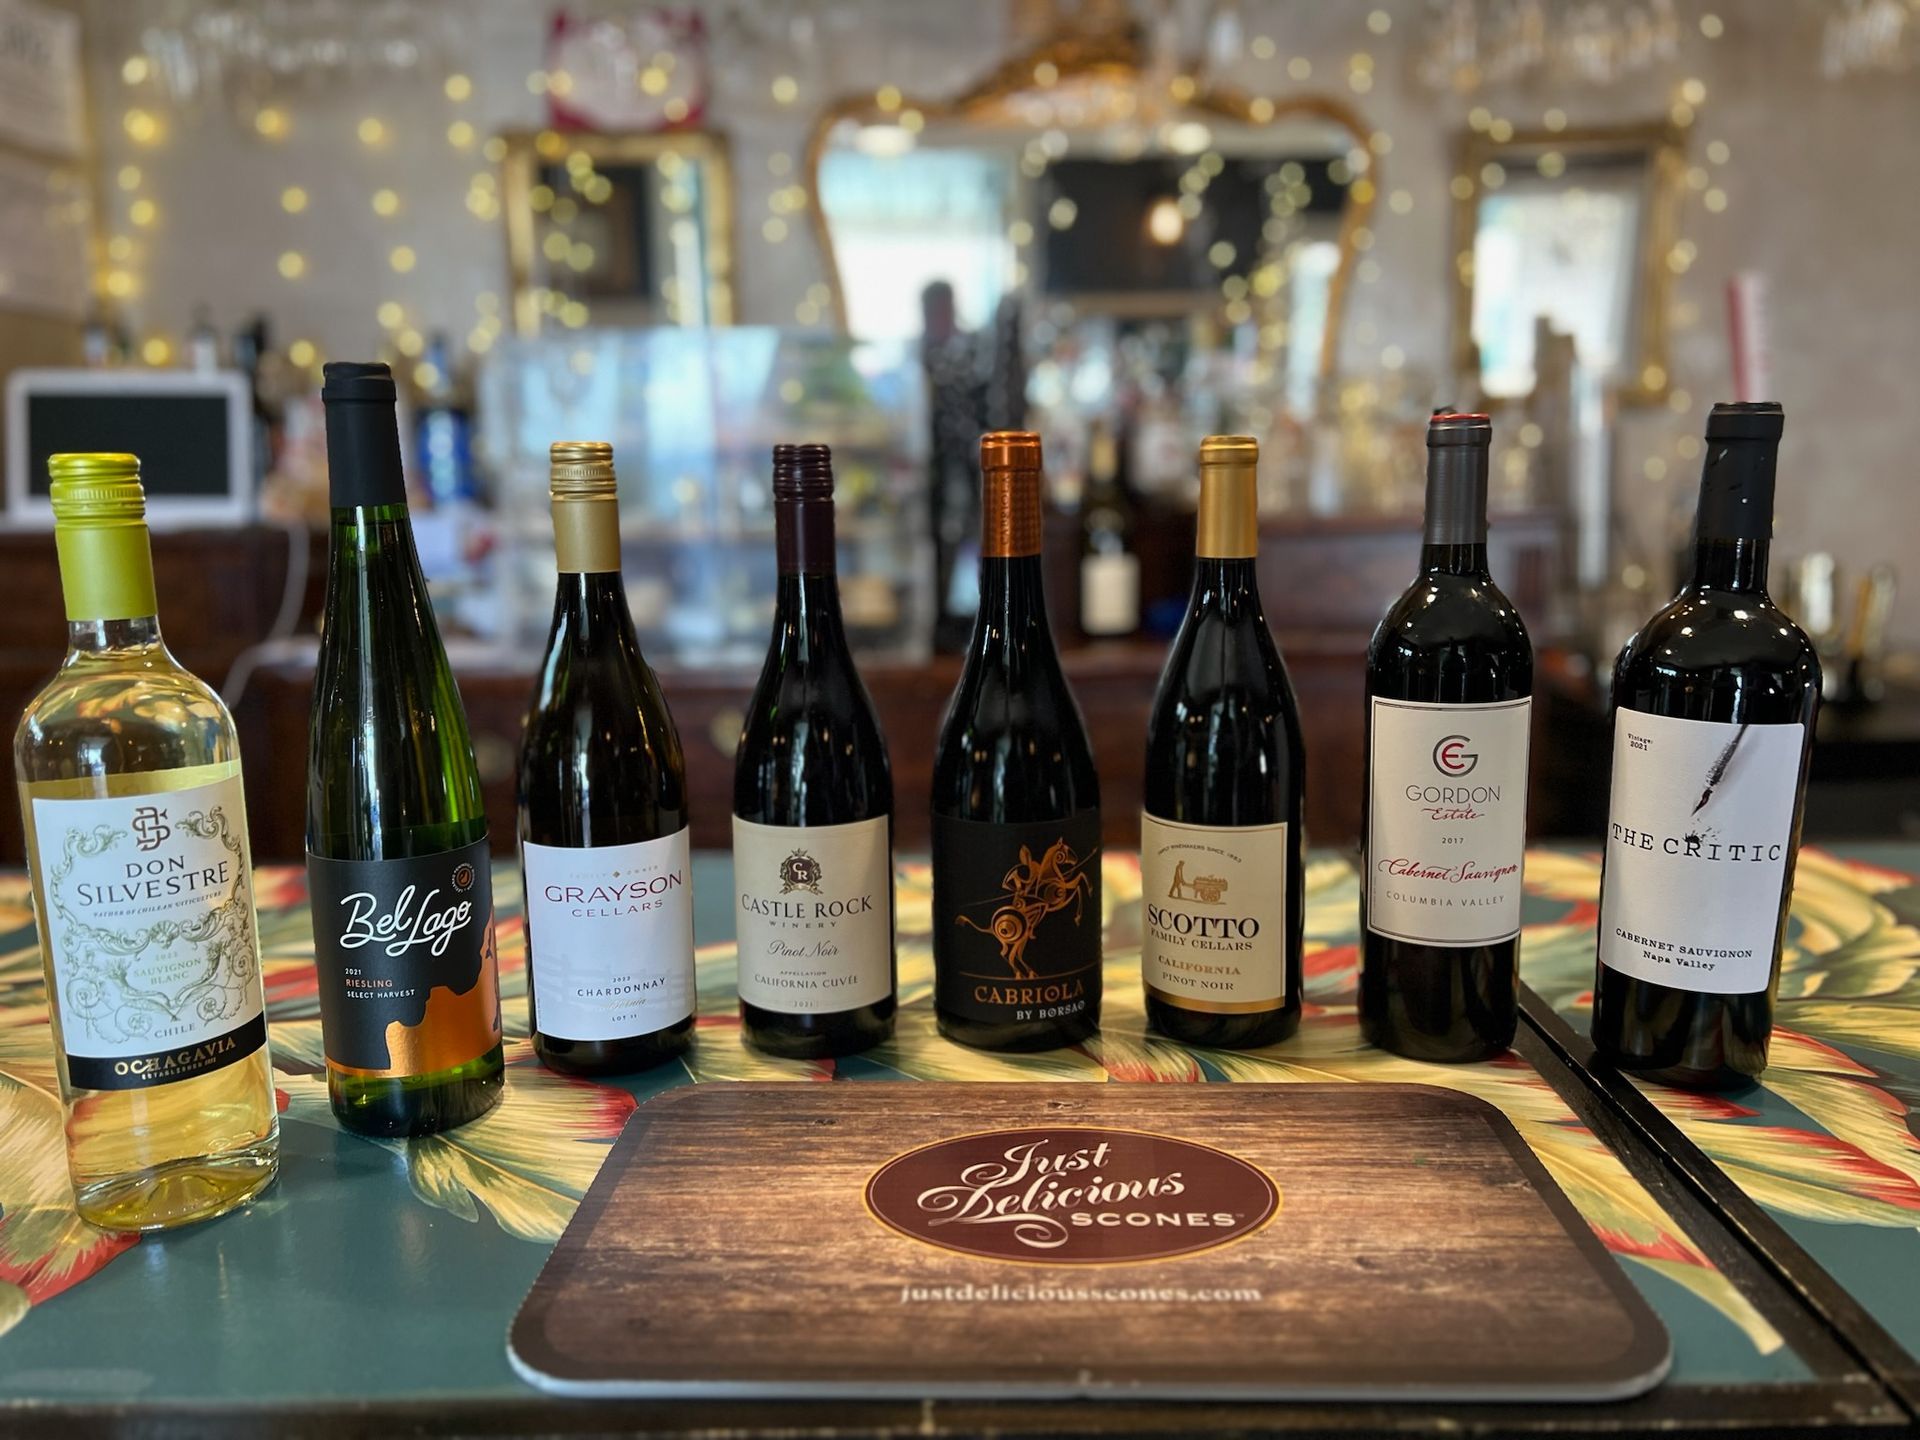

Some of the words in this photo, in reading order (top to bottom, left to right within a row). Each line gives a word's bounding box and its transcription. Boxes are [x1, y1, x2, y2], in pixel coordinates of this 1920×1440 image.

[1629, 740, 1648, 750] 2021
[1405, 784, 1500, 804] GORDON
[1421, 803, 1485, 821] Estate
[1612, 822, 1654, 851] THE
[1663, 833, 1781, 862] CRITIC
[126, 855, 185, 878] DON
[1377, 858, 1455, 881] Cabernet
[1450, 860, 1519, 883] Sauvignon
[77, 860, 230, 906] SILVESTRE
[545, 870, 682, 904] GRAYSON
[571, 899, 663, 918] CELLARS
[742, 893, 806, 918] CASTLE
[815, 895, 873, 918] ROCK
[1386, 890, 1453, 906] COLUMBIA
[1461, 895, 1505, 907] VALLEY
[769, 921, 837, 929] WINERY
[1148, 903, 1260, 939] SCOTTO
[767, 939, 805, 957] Pinot
[805, 940, 839, 958] Noir
[1151, 929, 1187, 946] FAMILY
[1191, 938, 1253, 951] CELLARS
[1615, 927, 1675, 952] CABERNET
[1679, 945, 1753, 959] SAUVIGNON
[134, 958, 201, 977] SAUVIGNON
[1158, 954, 1241, 975] CALIFORNIA
[1643, 950, 1671, 965] Napa
[1676, 957, 1716, 971] Valley
[151, 972, 189, 985] BLANC
[345, 968, 362, 976] 2021
[754, 974, 818, 989] CALIFORNIA
[823, 974, 858, 989] CUVÉE
[1162, 972, 1197, 987] PINOT
[1201, 981, 1234, 991] NOIR
[345, 979, 393, 988] RIESLING
[577, 977, 665, 997] CHARDONNAY
[974, 979, 1084, 1005] CABRIOLA
[347, 991, 374, 999] SELECT
[377, 989, 415, 999] HARVEST
[1016, 1009, 1032, 1020] BY
[1039, 1000, 1085, 1019] BORSAO
[154, 1023, 196, 1039] CHILE
[114, 1037, 236, 1076] OCHAGAVIA
[960, 1139, 1112, 1188] Just
[917, 1171, 1186, 1248] Delicious
[1071, 1212, 1236, 1228] SCONES
[900, 1284, 1262, 1305] justdeliciousscones.com
